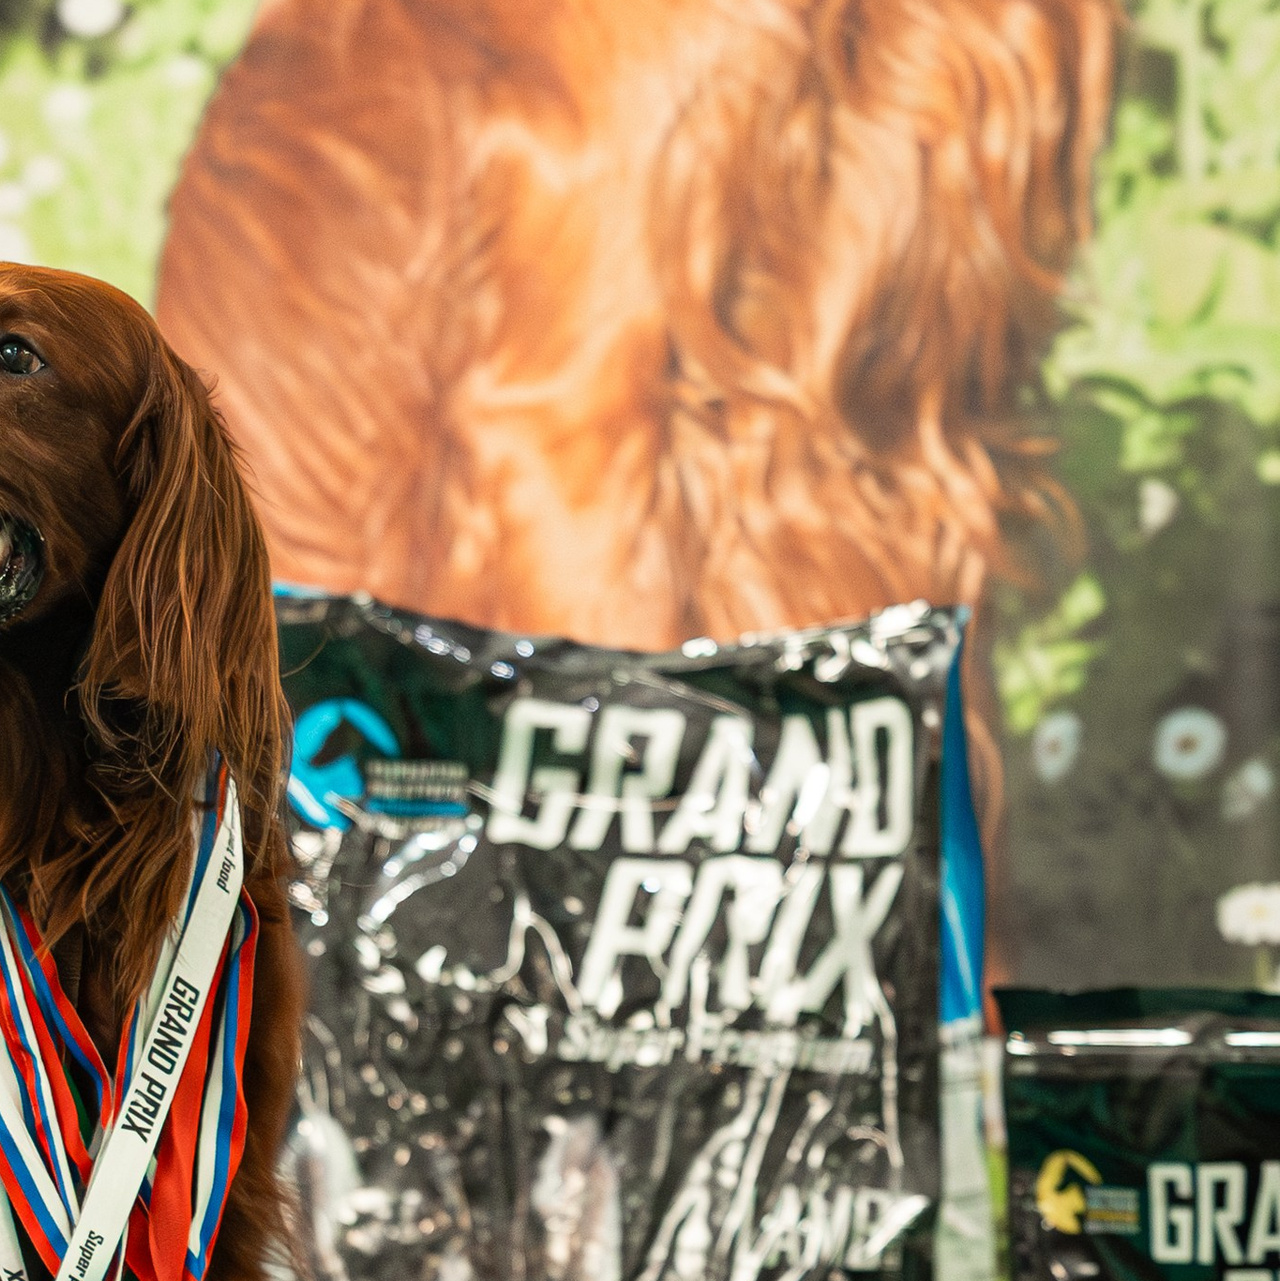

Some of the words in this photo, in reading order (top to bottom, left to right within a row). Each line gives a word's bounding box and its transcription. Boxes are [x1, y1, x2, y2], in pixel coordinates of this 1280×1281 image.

[486, 695, 915, 859] GRAND
[577, 853, 907, 1014] PRIX
[147, 975, 200, 1076] GRAND
[121, 1072, 167, 1144] PRIX
[76, 1230, 104, 1278] Super
